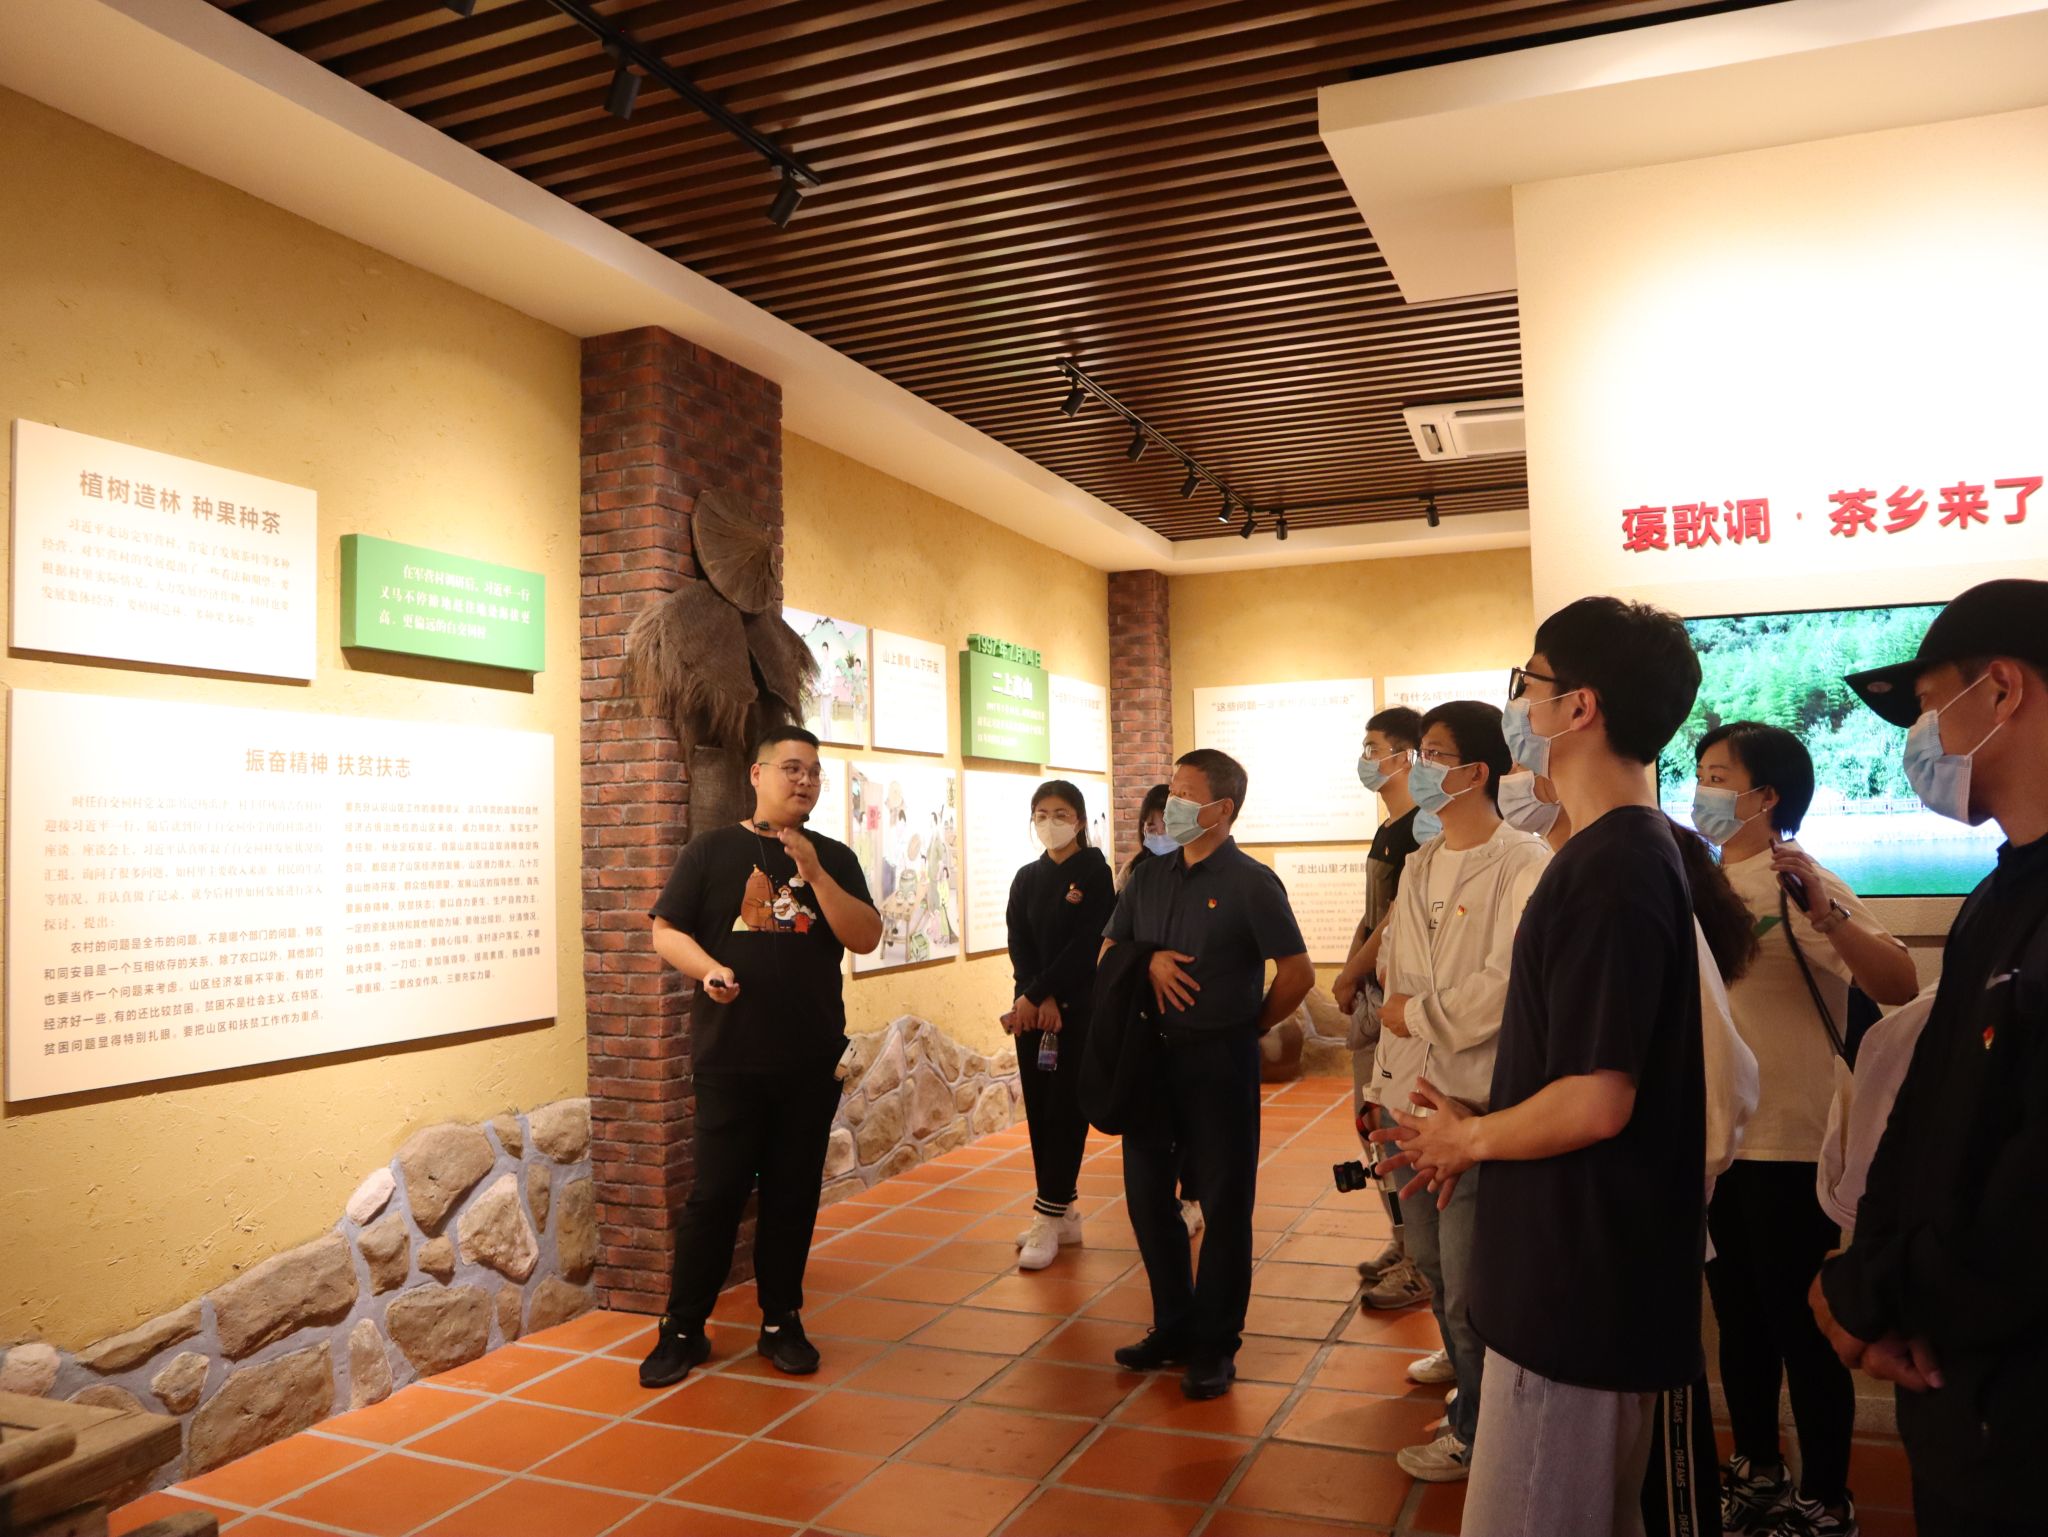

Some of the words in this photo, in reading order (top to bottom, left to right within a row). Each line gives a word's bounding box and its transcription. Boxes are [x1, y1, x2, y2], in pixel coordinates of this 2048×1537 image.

[79, 468, 181, 516] 植树造林
[191, 493, 281, 536] 种果种茶
[882, 648, 911, 669] 山上
[245, 747, 329, 776] 振奋精神
[337, 752, 411, 779] 扶贫扶志
[1674, 1449, 1686, 1488] DREAMS
